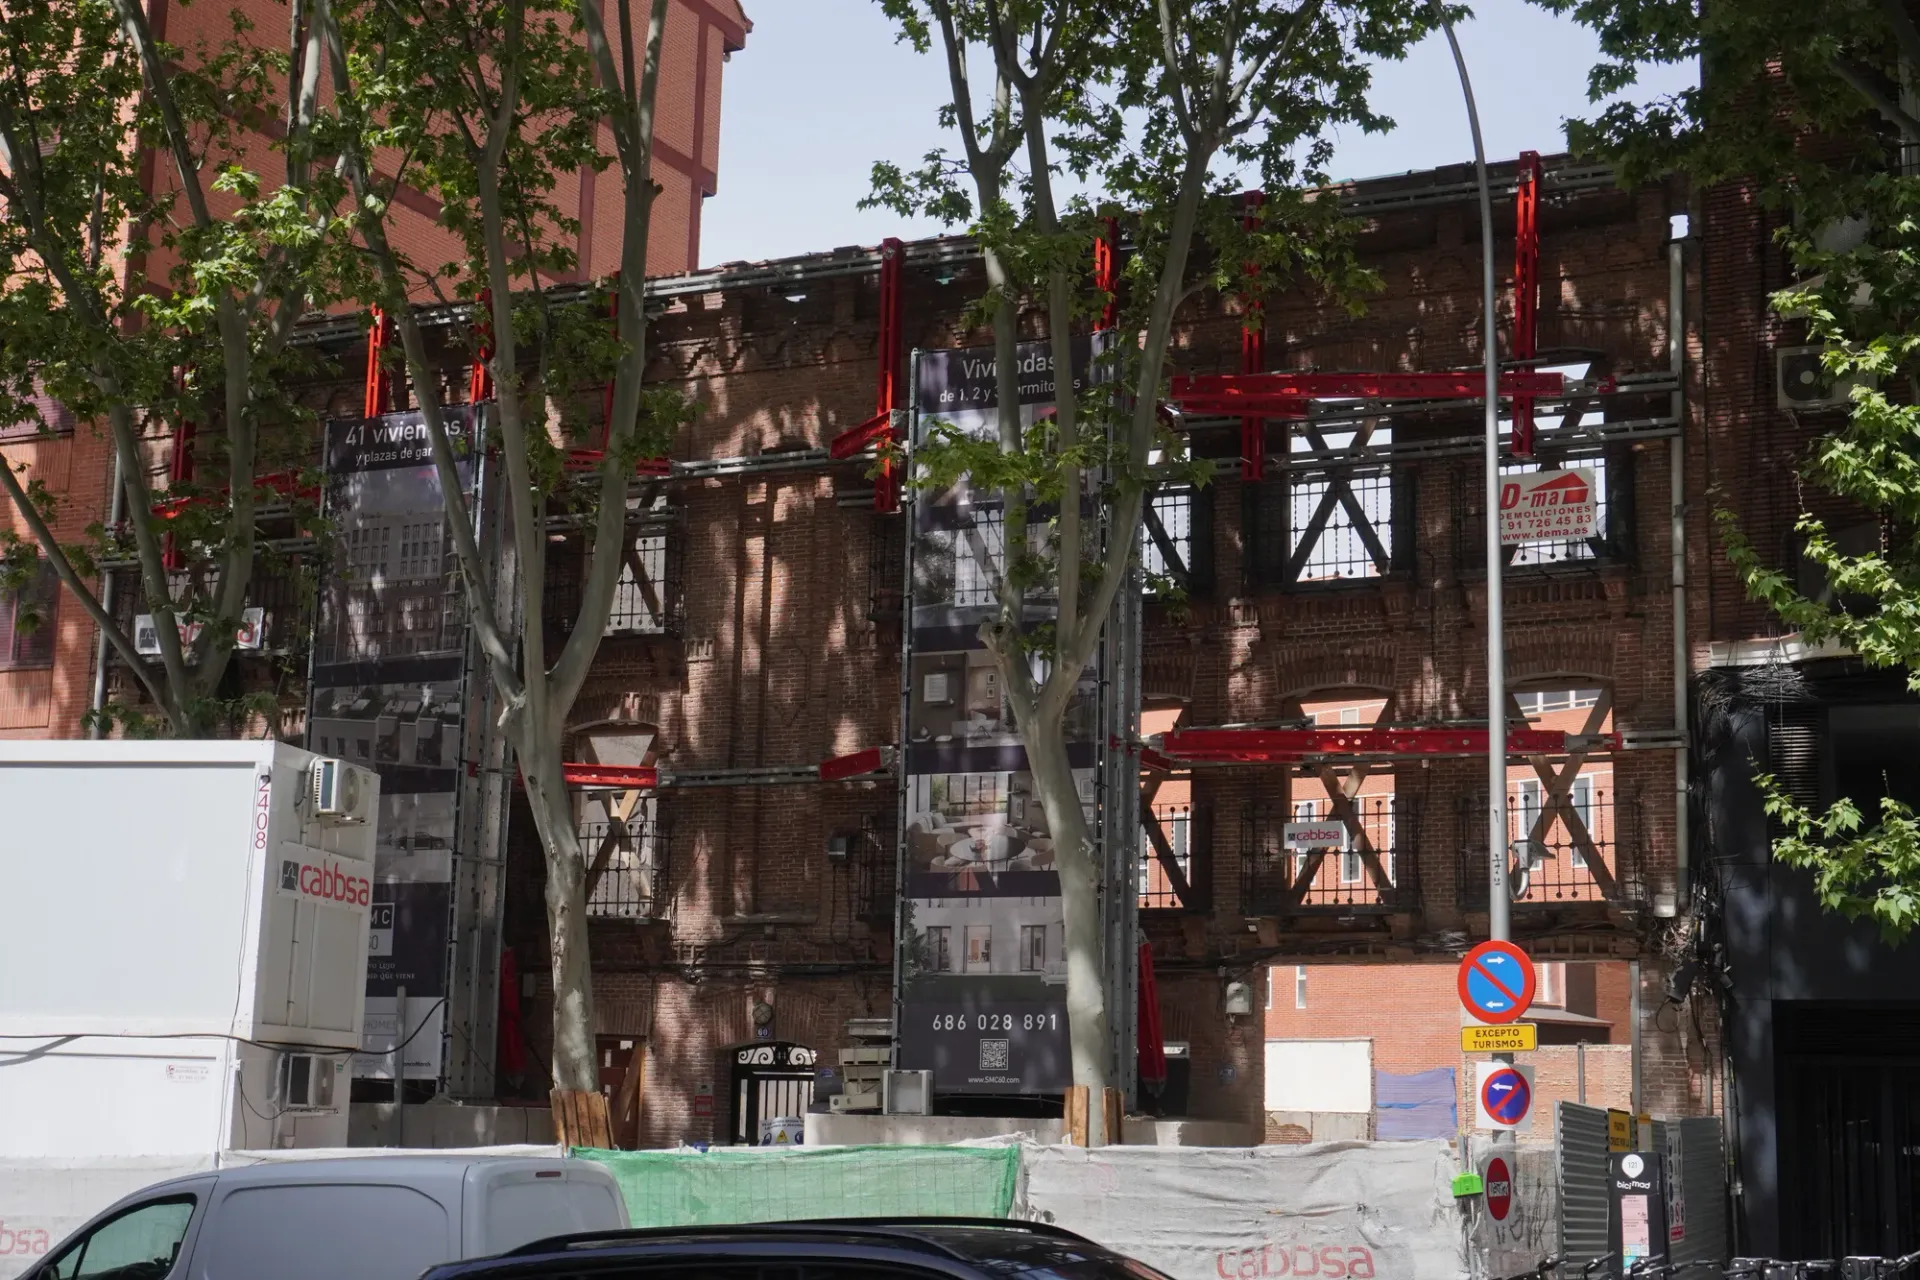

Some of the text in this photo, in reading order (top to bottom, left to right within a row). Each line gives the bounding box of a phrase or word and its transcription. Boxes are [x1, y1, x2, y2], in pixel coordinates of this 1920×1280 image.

[963, 353, 1055, 379] Vividas
[939, 389, 954, 403] de
[972, 386, 980, 400] 2
[983, 387, 991, 401] y
[345, 420, 461, 446] 41 vivienas
[356, 446, 433, 466] y plazas de gar
[1500, 483, 1559, 510] D-ma
[1500, 505, 1591, 520] DEMOLICIONES
[1508, 521, 1522, 530] 91
[1529, 518, 1551, 528] 726
[1556, 516, 1571, 526] 45
[1576, 515, 1591, 524] 83
[1502, 527, 1588, 541] www.dema.es
[255, 774, 271, 849] 2408
[1296, 829, 1340, 841] cabbsa
[300, 859, 369, 906] cabbsa
[932, 1014, 1057, 1031] 686 028 891
[1475, 1028, 1520, 1038] EXCEPTO
[1473, 1039, 1524, 1049] TURISMOS
[968, 1075, 1020, 1083] www.SMC60.com
[1627, 1161, 1638, 1169] 121
